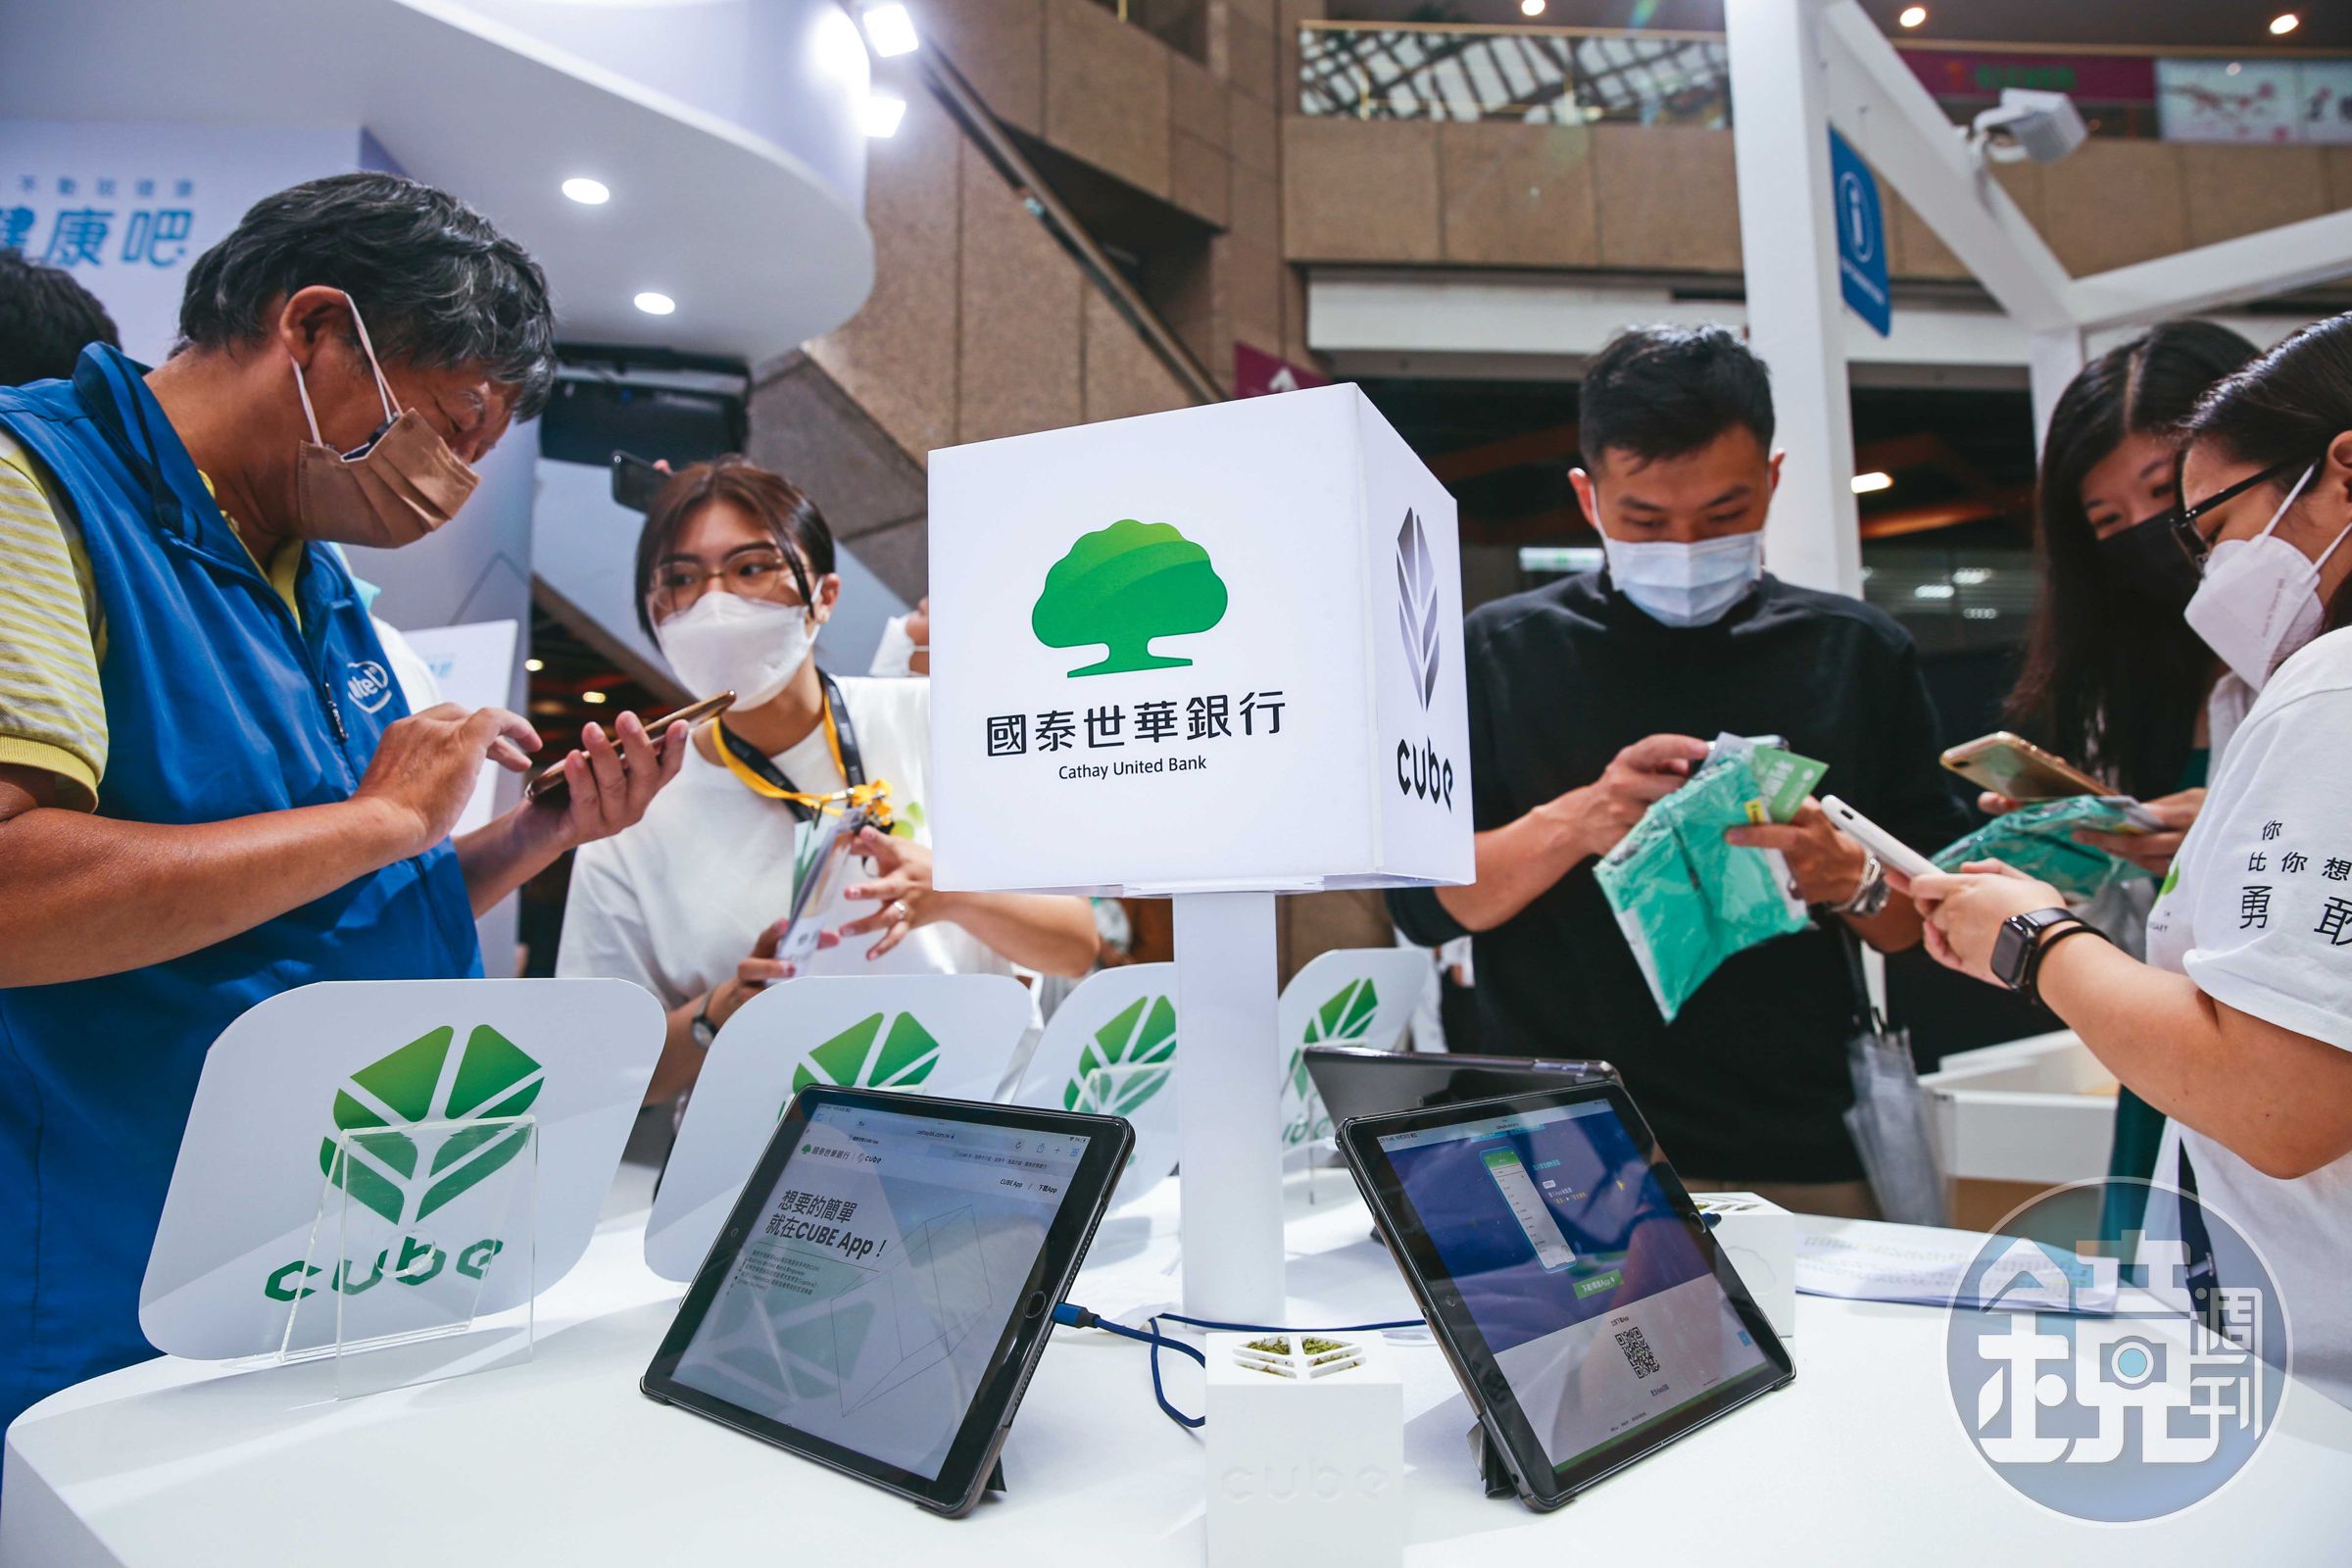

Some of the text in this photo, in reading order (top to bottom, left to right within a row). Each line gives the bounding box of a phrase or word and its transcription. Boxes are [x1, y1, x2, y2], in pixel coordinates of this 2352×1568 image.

[987, 691, 1286, 757] 國泰世華銀行
[1058, 756, 1206, 780] Cathay United Bank
[1396, 734, 1453, 813] cube
[2261, 819, 2283, 841] 你
[2248, 851, 2352, 881] 比你想
[864, 1154, 882, 1164] cube
[778, 1189, 858, 1224] 想要的簡單
[765, 1212, 840, 1247] 就在CUBE
[264, 1236, 504, 1302] cube
